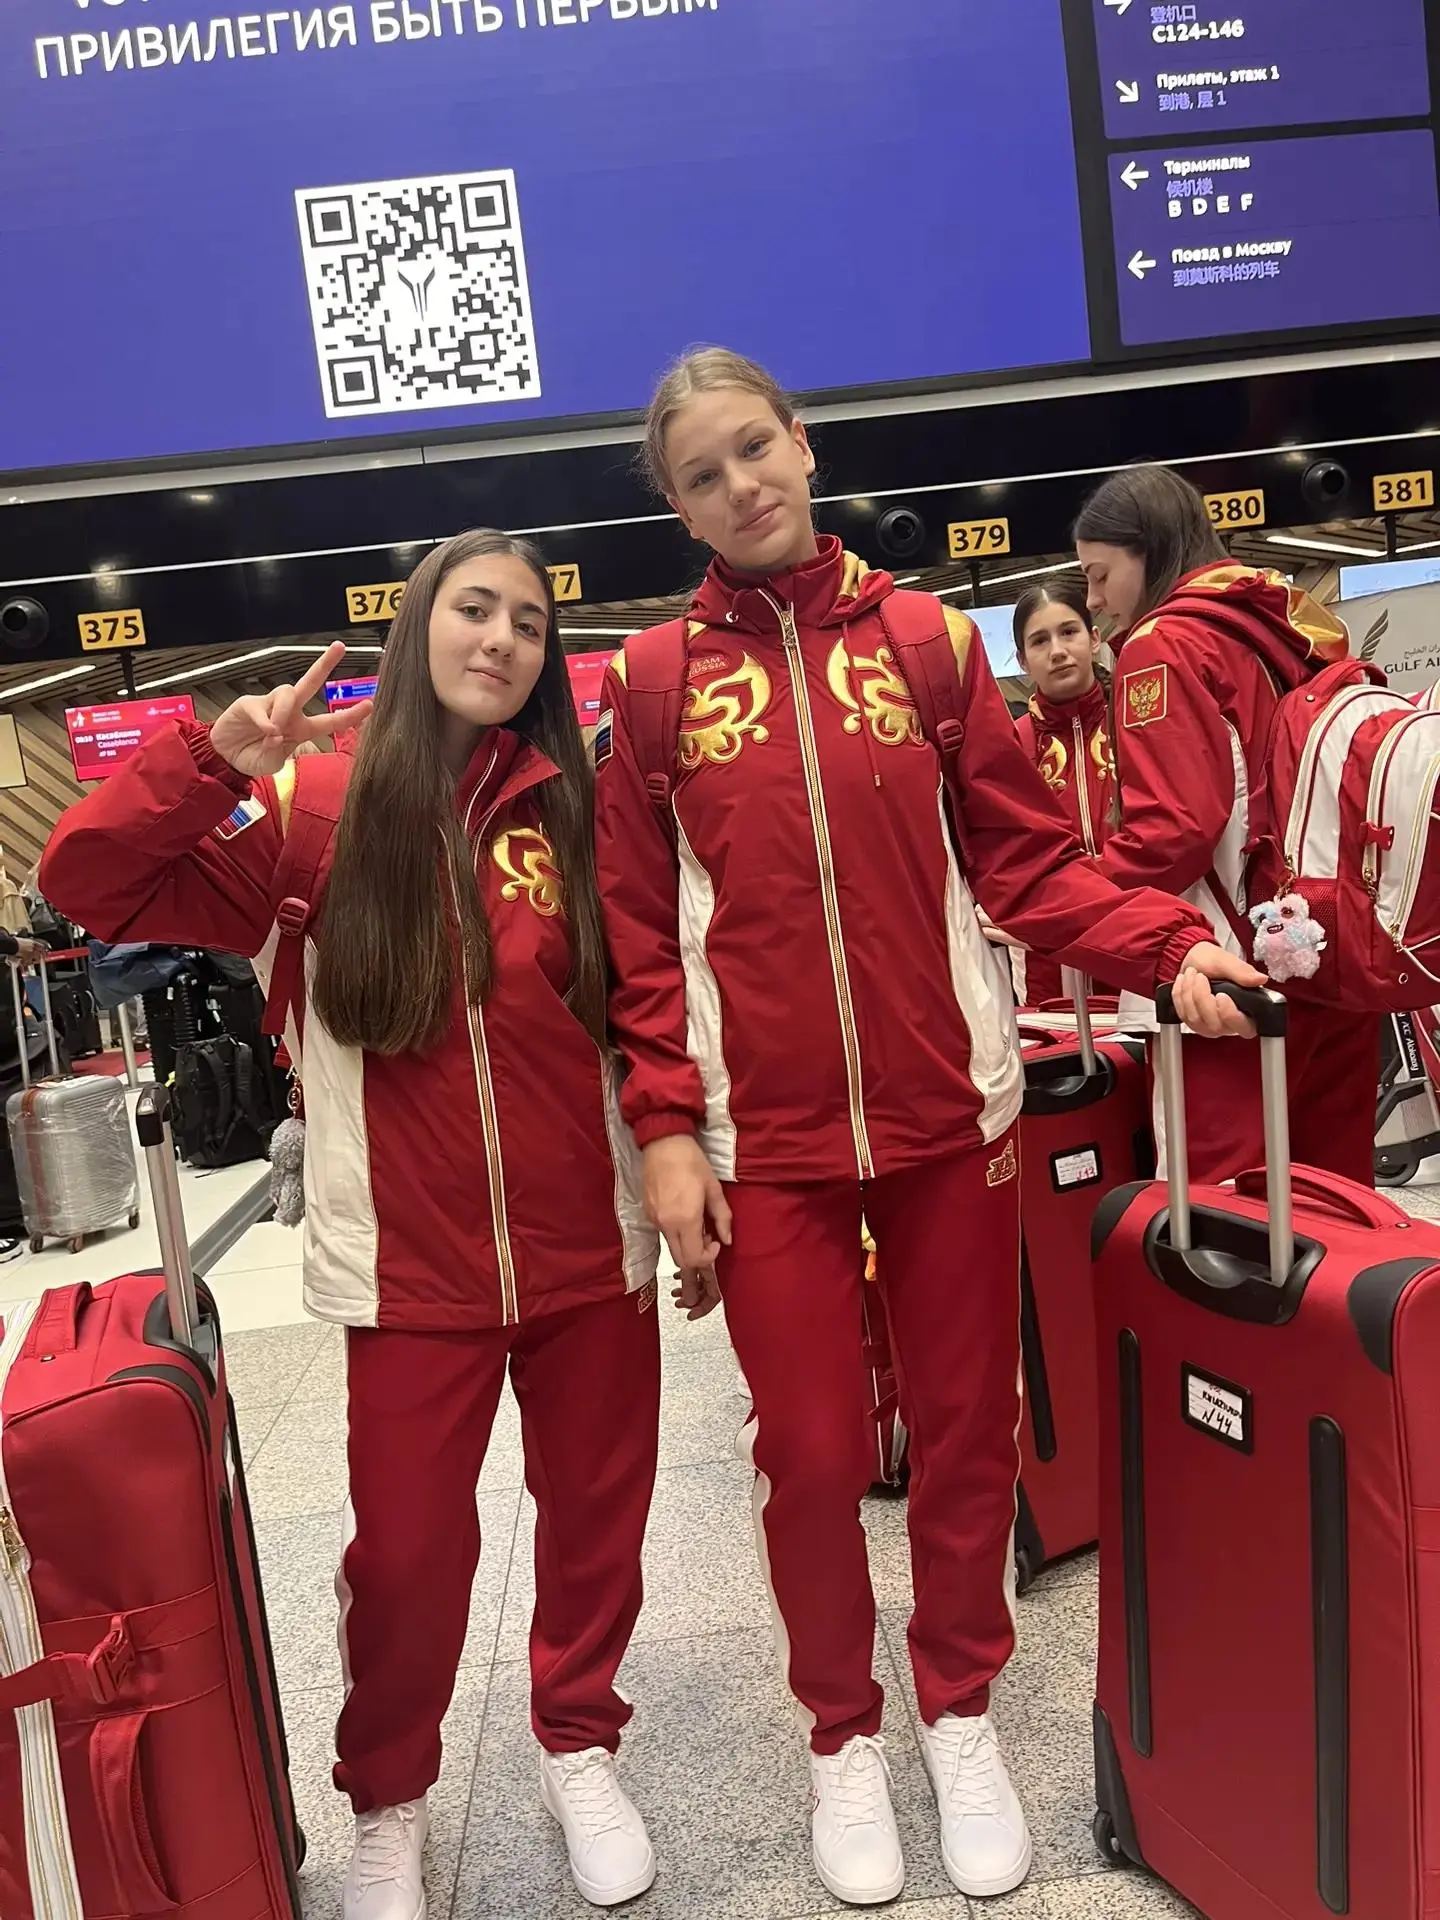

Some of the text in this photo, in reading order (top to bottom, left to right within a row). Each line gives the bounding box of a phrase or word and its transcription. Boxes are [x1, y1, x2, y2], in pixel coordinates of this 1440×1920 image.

[1150, 4, 1197, 24] 登机口
[35, 0, 718, 79] ПРИВИЛЕГИЯ БЫТЬ ПЕРВ
[1152, 19, 1245, 43] C124-146
[1229, 68, 1268, 83] этаж
[1270, 65, 1280, 80] 1
[1216, 90, 1227, 106] 1
[1163, 156, 1251, 176] Терминалы
[1166, 177, 1214, 199] 候机楼
[1168, 193, 1254, 217] B D E F
[1171, 240, 1292, 264] Поезд в Москву
[1379, 477, 1426, 504] 381
[1209, 496, 1261, 523] 380
[953, 525, 1005, 552] 379
[352, 588, 403, 616] 376
[84, 616, 140, 643] 375
[1384, 656, 1440, 674] GULF AI
